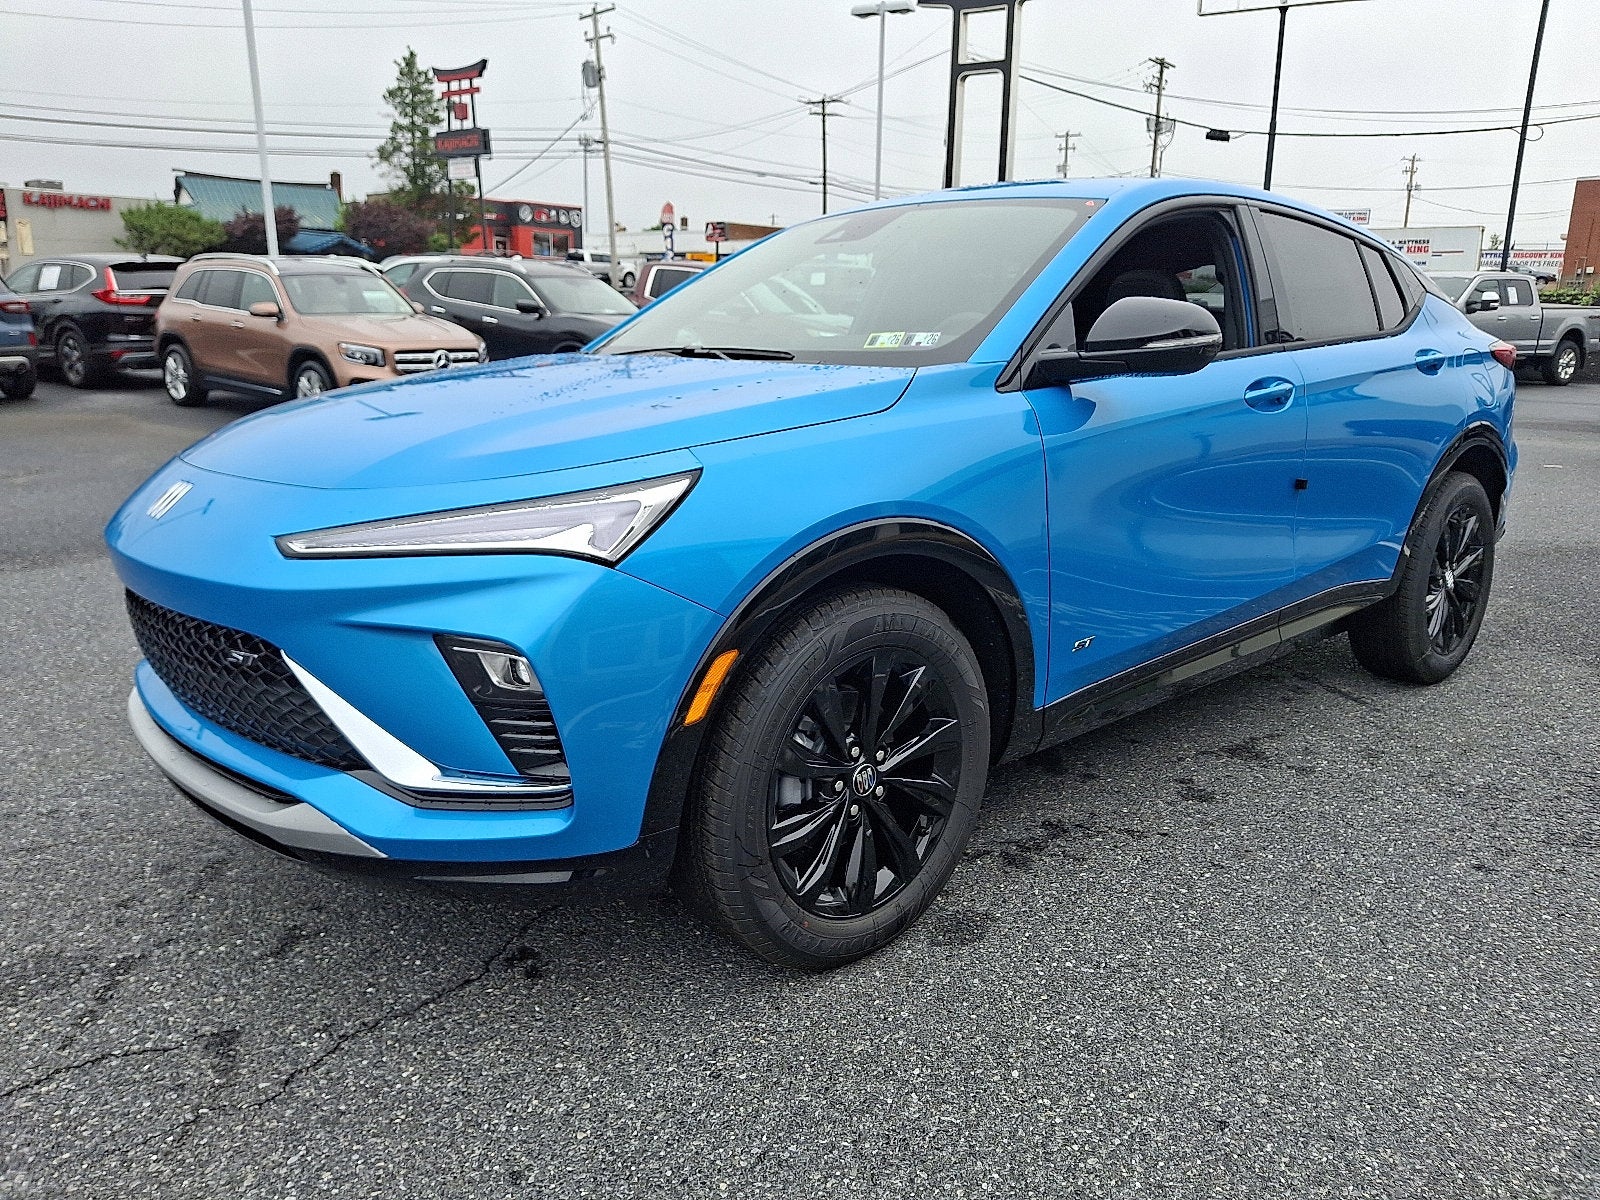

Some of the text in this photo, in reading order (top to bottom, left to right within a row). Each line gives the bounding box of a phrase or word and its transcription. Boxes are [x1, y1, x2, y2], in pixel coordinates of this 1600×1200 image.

[1406, 245, 1429, 253] KING
[1072, 635, 1096, 652] ST
[226, 649, 258, 666] ST
